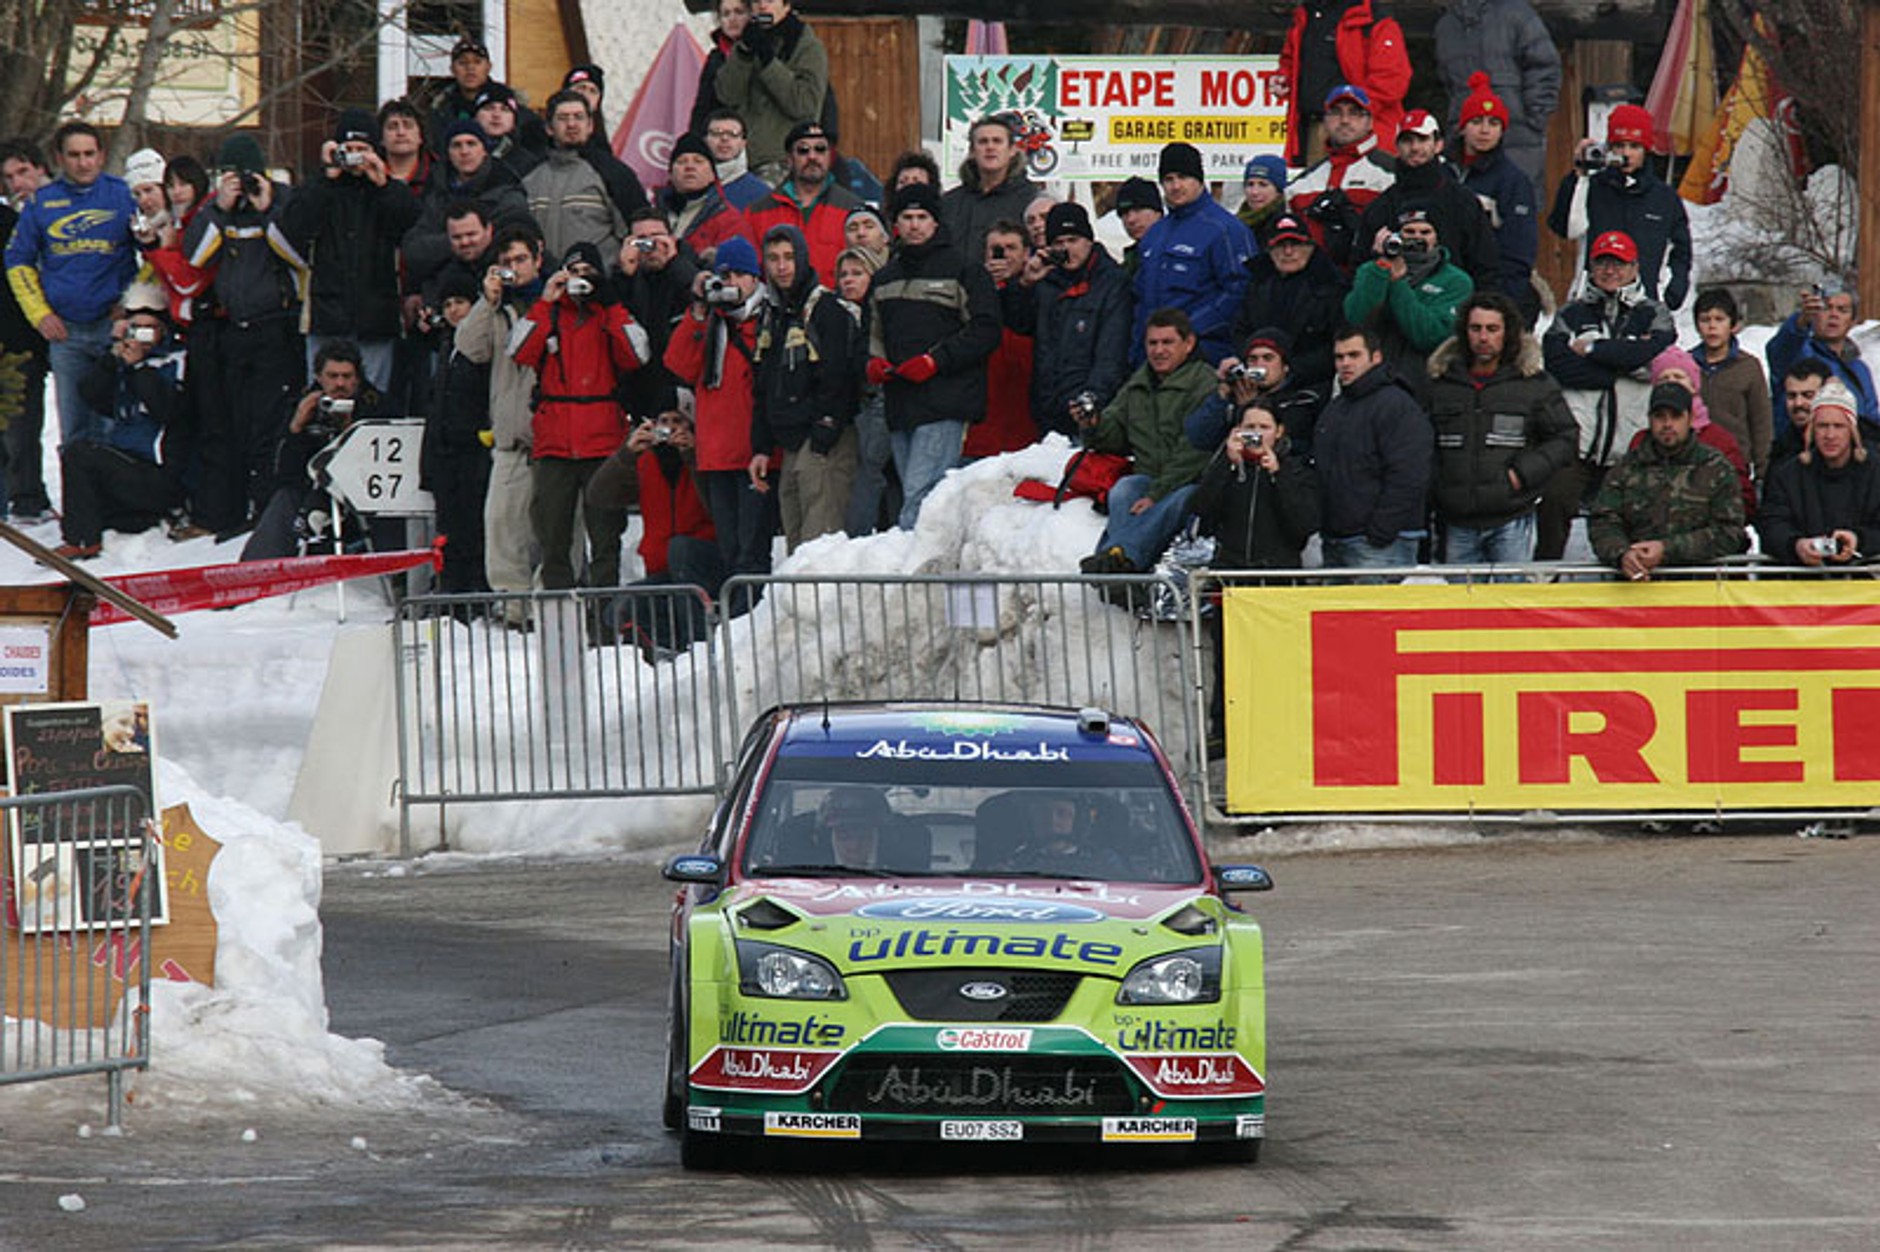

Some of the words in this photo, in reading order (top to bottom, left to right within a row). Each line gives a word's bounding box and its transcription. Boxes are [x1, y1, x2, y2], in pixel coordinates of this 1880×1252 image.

[1060, 70, 1175, 107] ETAPE
[1113, 120, 1176, 140] GARAGE
[1183, 120, 1249, 140] GRATUIT
[1092, 154, 1123, 168] FREE
[370, 437, 403, 463] 12
[367, 474, 403, 499] 67
[0, 667, 36, 678] OIDES
[901, 898, 1060, 919] Ford
[849, 930, 1123, 965] ultimate
[719, 1011, 846, 1046] ultimate
[959, 1030, 1027, 1049] Castrol
[1118, 1019, 1238, 1051] ultimate
[944, 1122, 984, 1137] EU07
[987, 1122, 1020, 1138] SSZ
